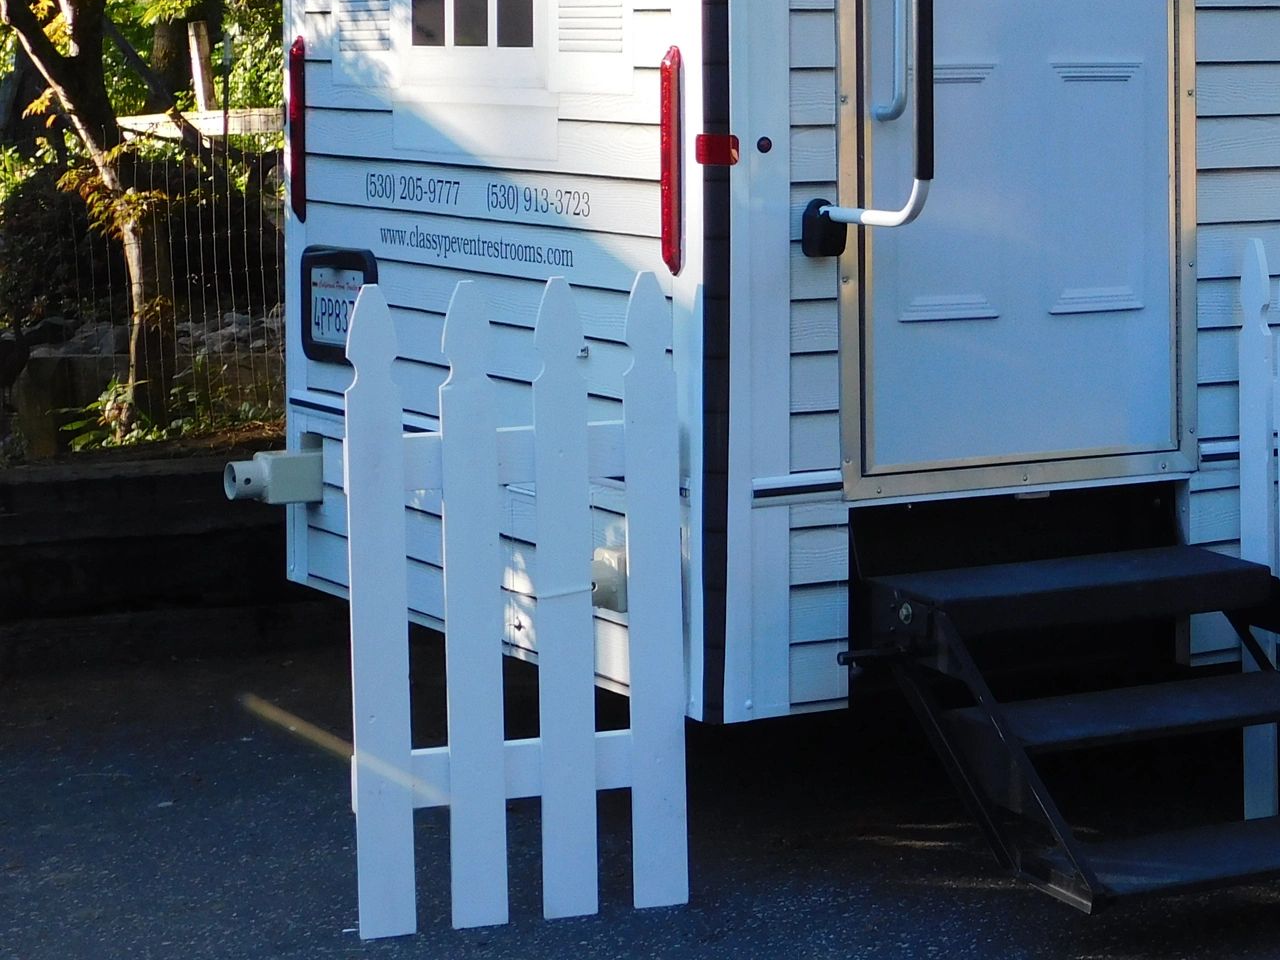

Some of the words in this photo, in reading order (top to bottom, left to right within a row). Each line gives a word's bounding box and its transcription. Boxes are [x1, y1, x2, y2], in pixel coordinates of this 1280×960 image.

[365, 171, 396, 204] (530)
[399, 176, 461, 205] 205-9777
[486, 181, 519, 213] (530)
[523, 185, 592, 217] 913-3723
[380, 225, 574, 268] www.classypeventrestrooms.com
